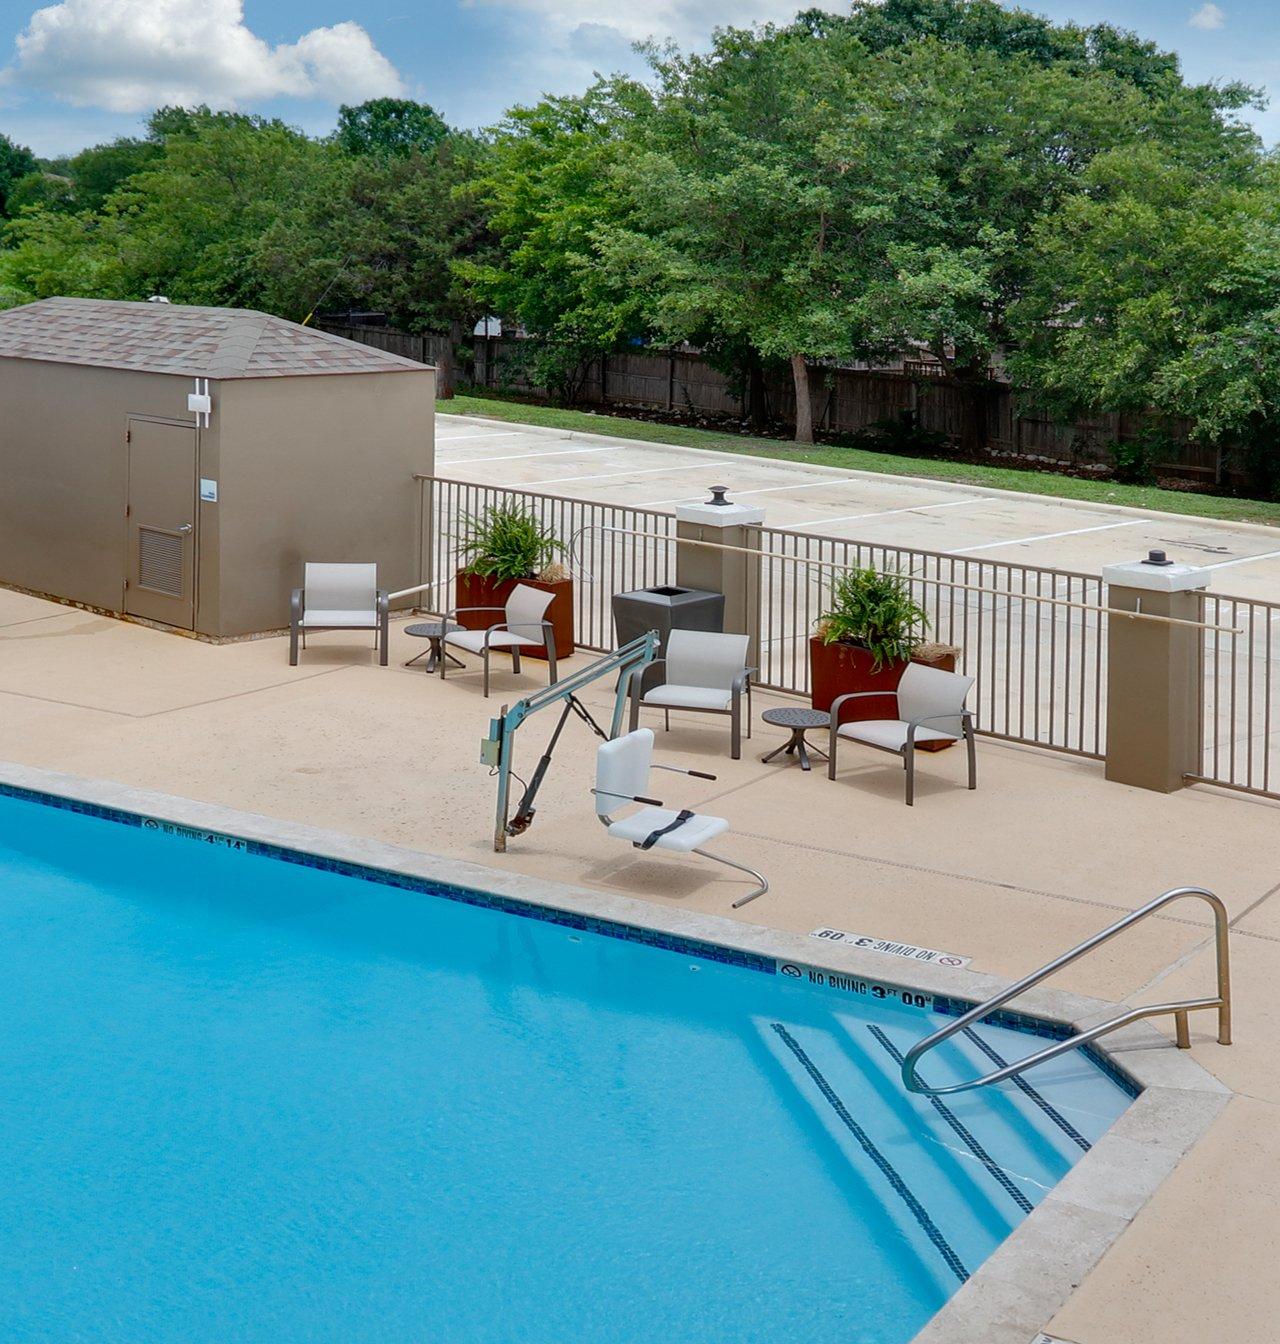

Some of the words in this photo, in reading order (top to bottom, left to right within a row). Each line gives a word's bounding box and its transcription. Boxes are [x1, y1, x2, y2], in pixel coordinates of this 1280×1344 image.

[163, 824, 174, 835] NO
[177, 827, 203, 842] DIVING
[855, 938, 874, 947] 3
[873, 941, 916, 957] DIVING
[917, 950, 938, 961] NO
[808, 970, 824, 986] NO
[829, 975, 867, 995] DIVING
[871, 985, 886, 999] 3
